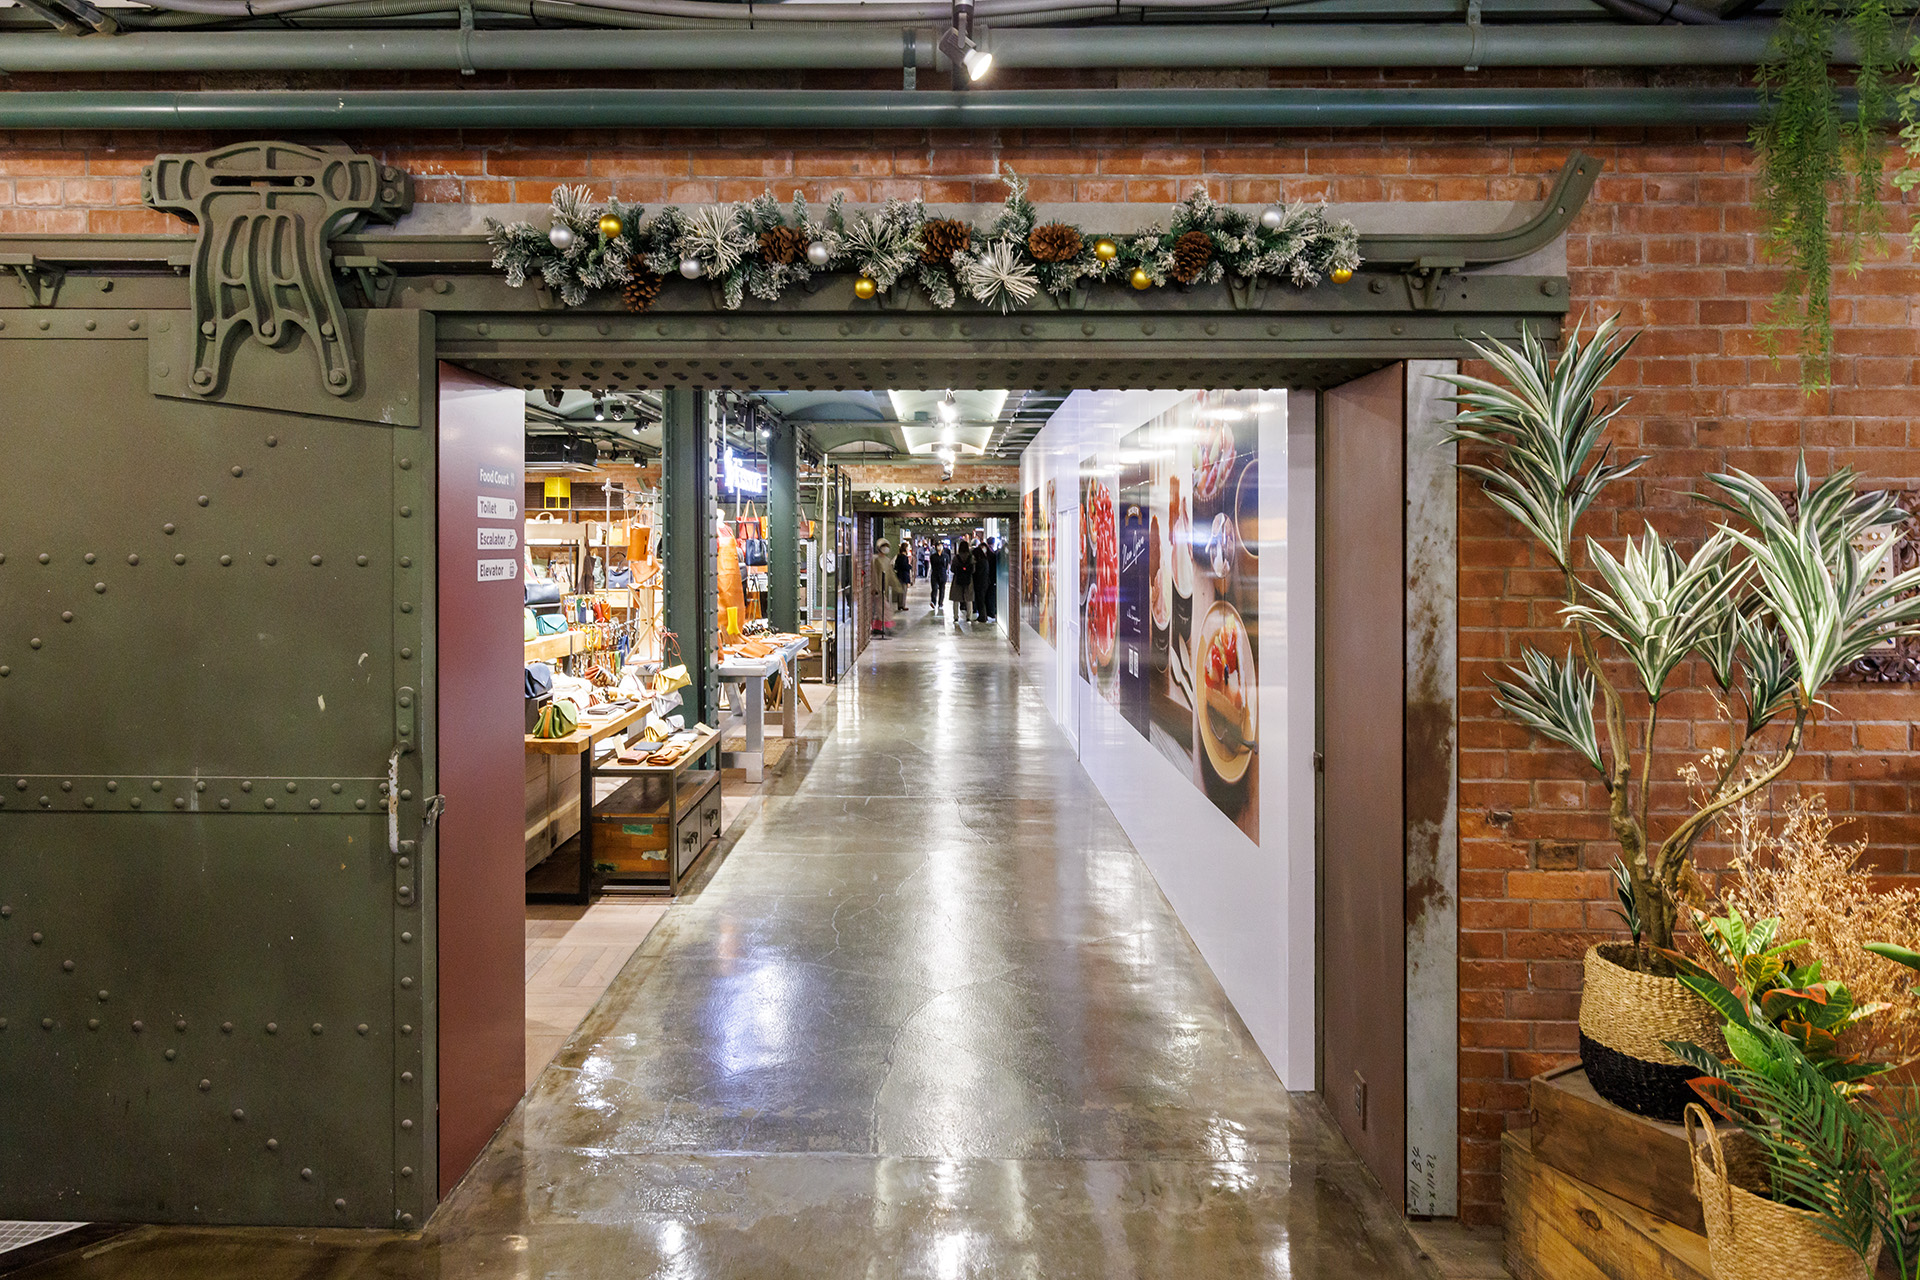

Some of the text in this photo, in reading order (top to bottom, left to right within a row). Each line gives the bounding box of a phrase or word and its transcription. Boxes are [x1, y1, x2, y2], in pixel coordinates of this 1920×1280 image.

[480, 468, 509, 485] Food Court
[480, 501, 497, 514] Toilet
[480, 533, 506, 545] Escalator
[480, 564, 504, 577] Elevator
